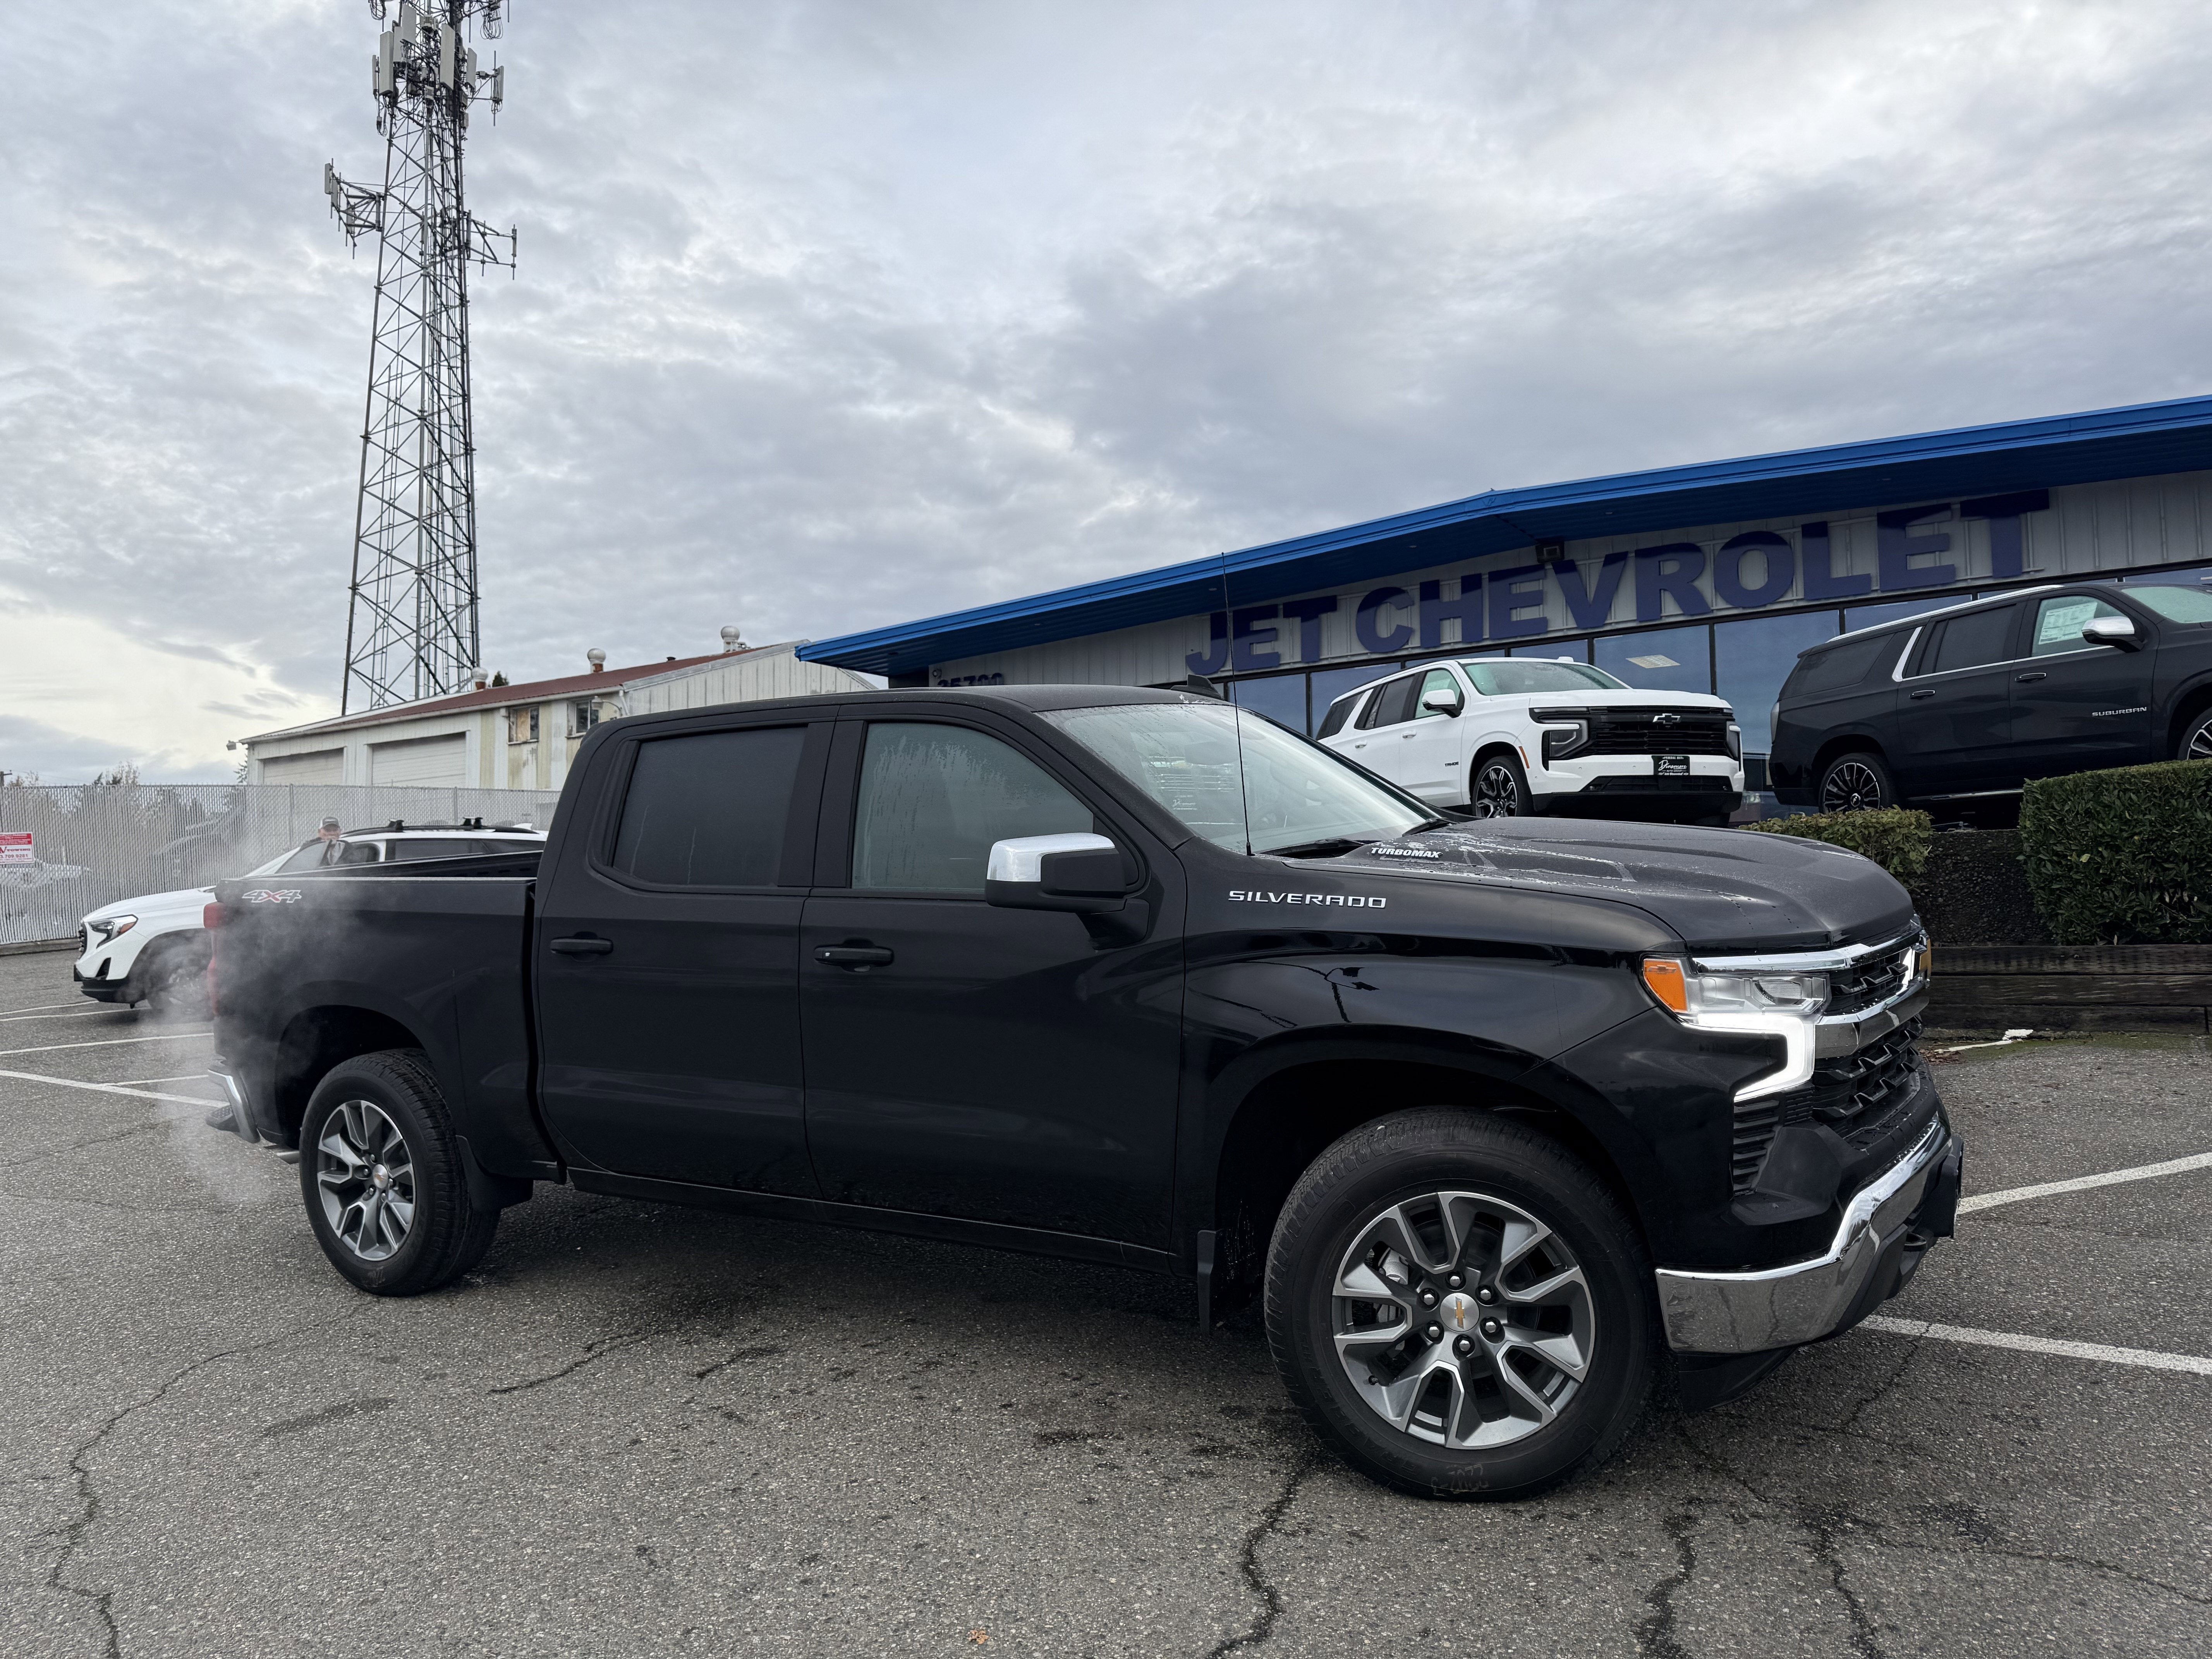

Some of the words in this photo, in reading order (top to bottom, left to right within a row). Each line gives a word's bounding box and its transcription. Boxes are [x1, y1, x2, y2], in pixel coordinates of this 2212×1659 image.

[1185, 595, 1337, 675] JET
[1355, 488, 2049, 653] CHEVROLET
[2092, 707, 2147, 716] SUBURBAN
[1371, 847, 1443, 858] TURBOMAX
[1228, 891, 1386, 908] SILVERADO
